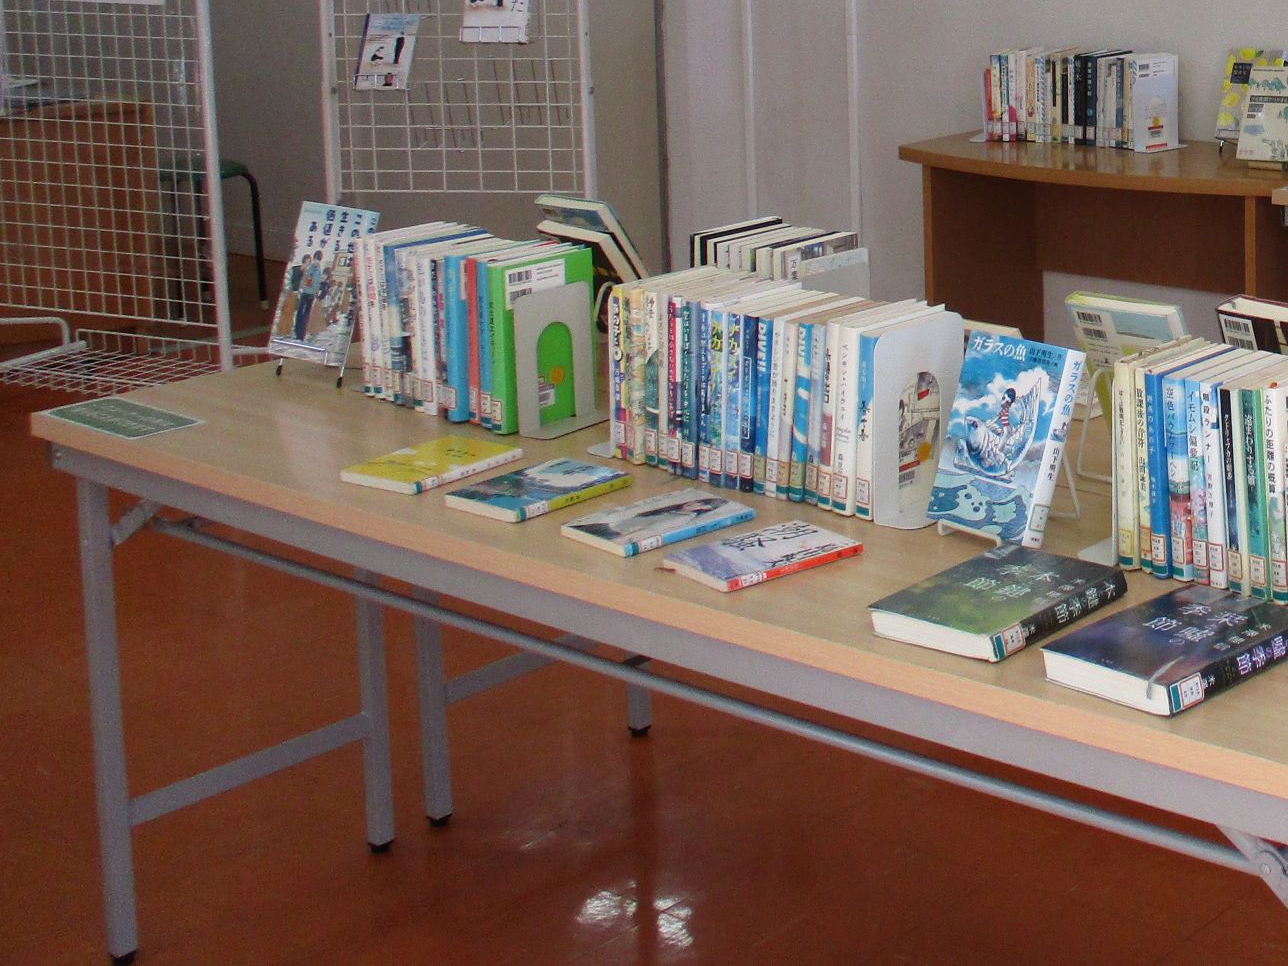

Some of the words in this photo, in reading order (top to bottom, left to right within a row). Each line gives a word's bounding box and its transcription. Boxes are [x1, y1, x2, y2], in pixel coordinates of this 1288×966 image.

[973, 336, 1028, 362] ガラスの魚
[1061, 360, 1082, 416] ガラスの魚
[1202, 392, 1212, 463] 階段ランナー
[1264, 395, 1276, 494] ふたりの距離の概算
